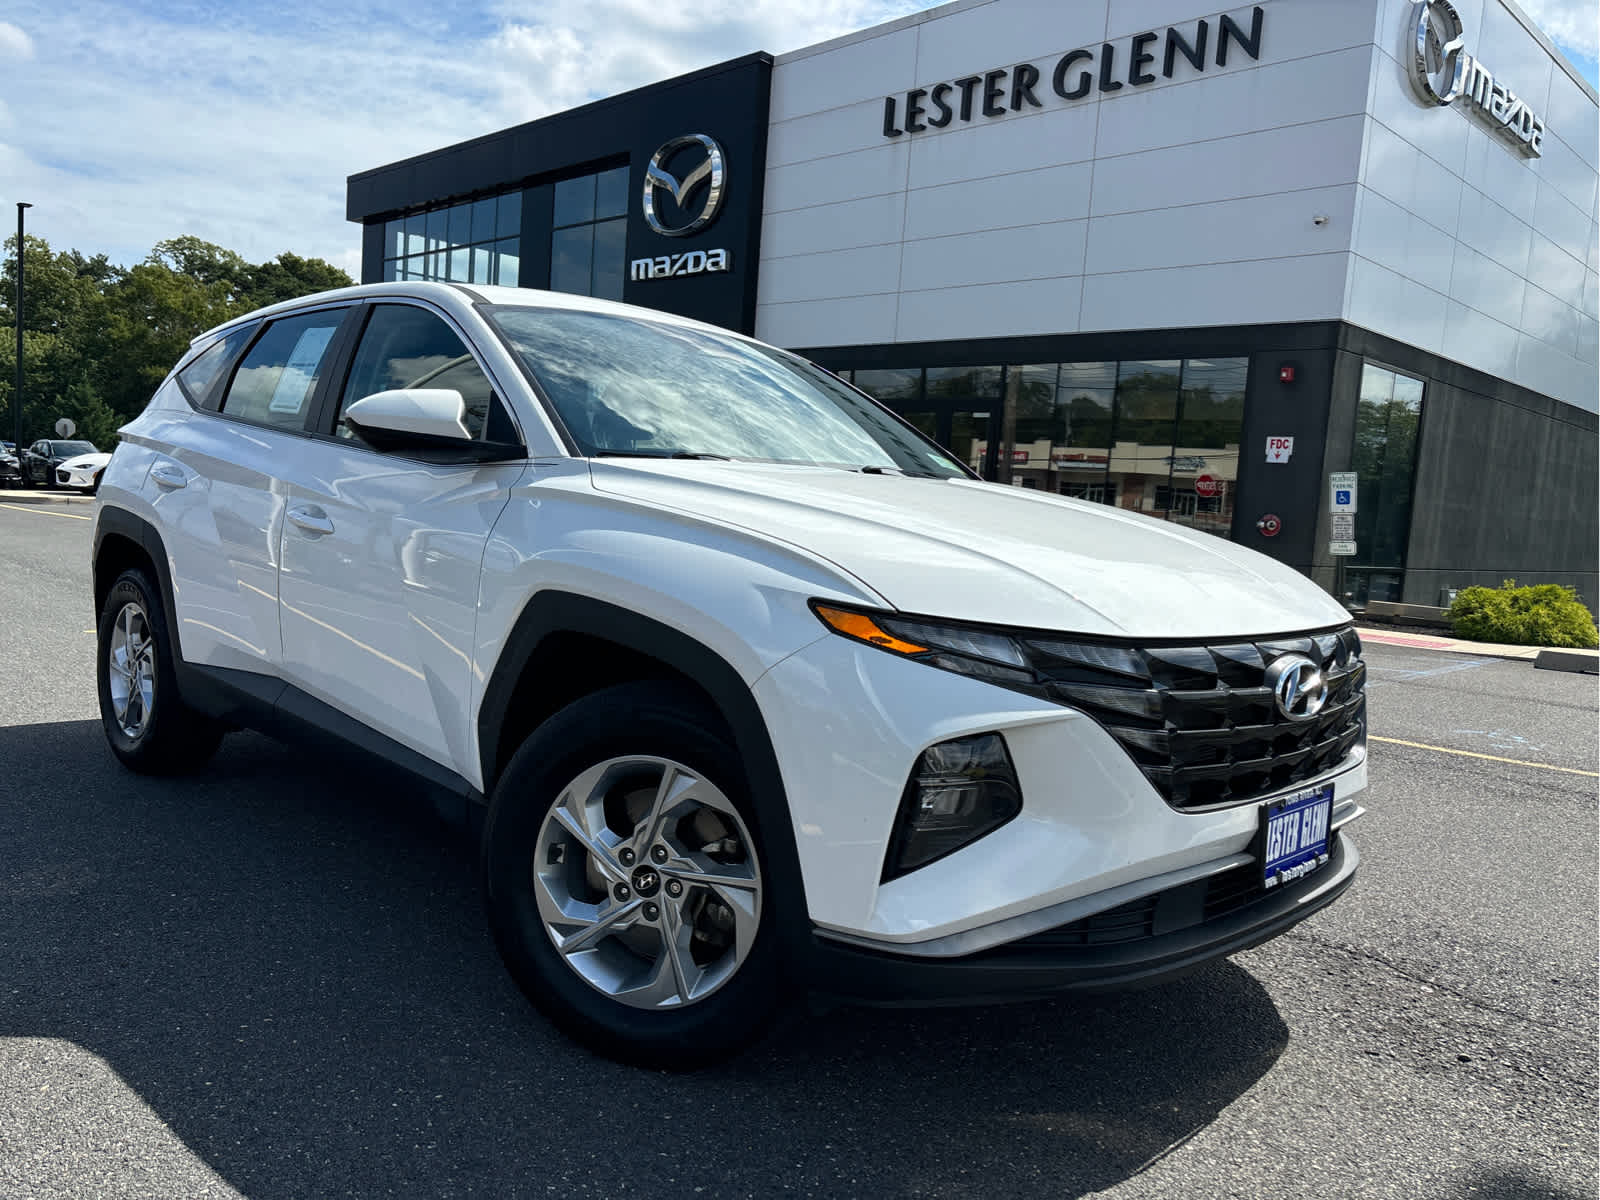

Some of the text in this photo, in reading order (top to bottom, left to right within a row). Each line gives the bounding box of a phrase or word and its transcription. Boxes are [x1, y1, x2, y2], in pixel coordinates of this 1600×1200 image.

[883, 6, 1264, 138] LESTER GLENN
[1270, 439, 1289, 449] FDC
[1266, 800, 1330, 863] LESTER GLENN
